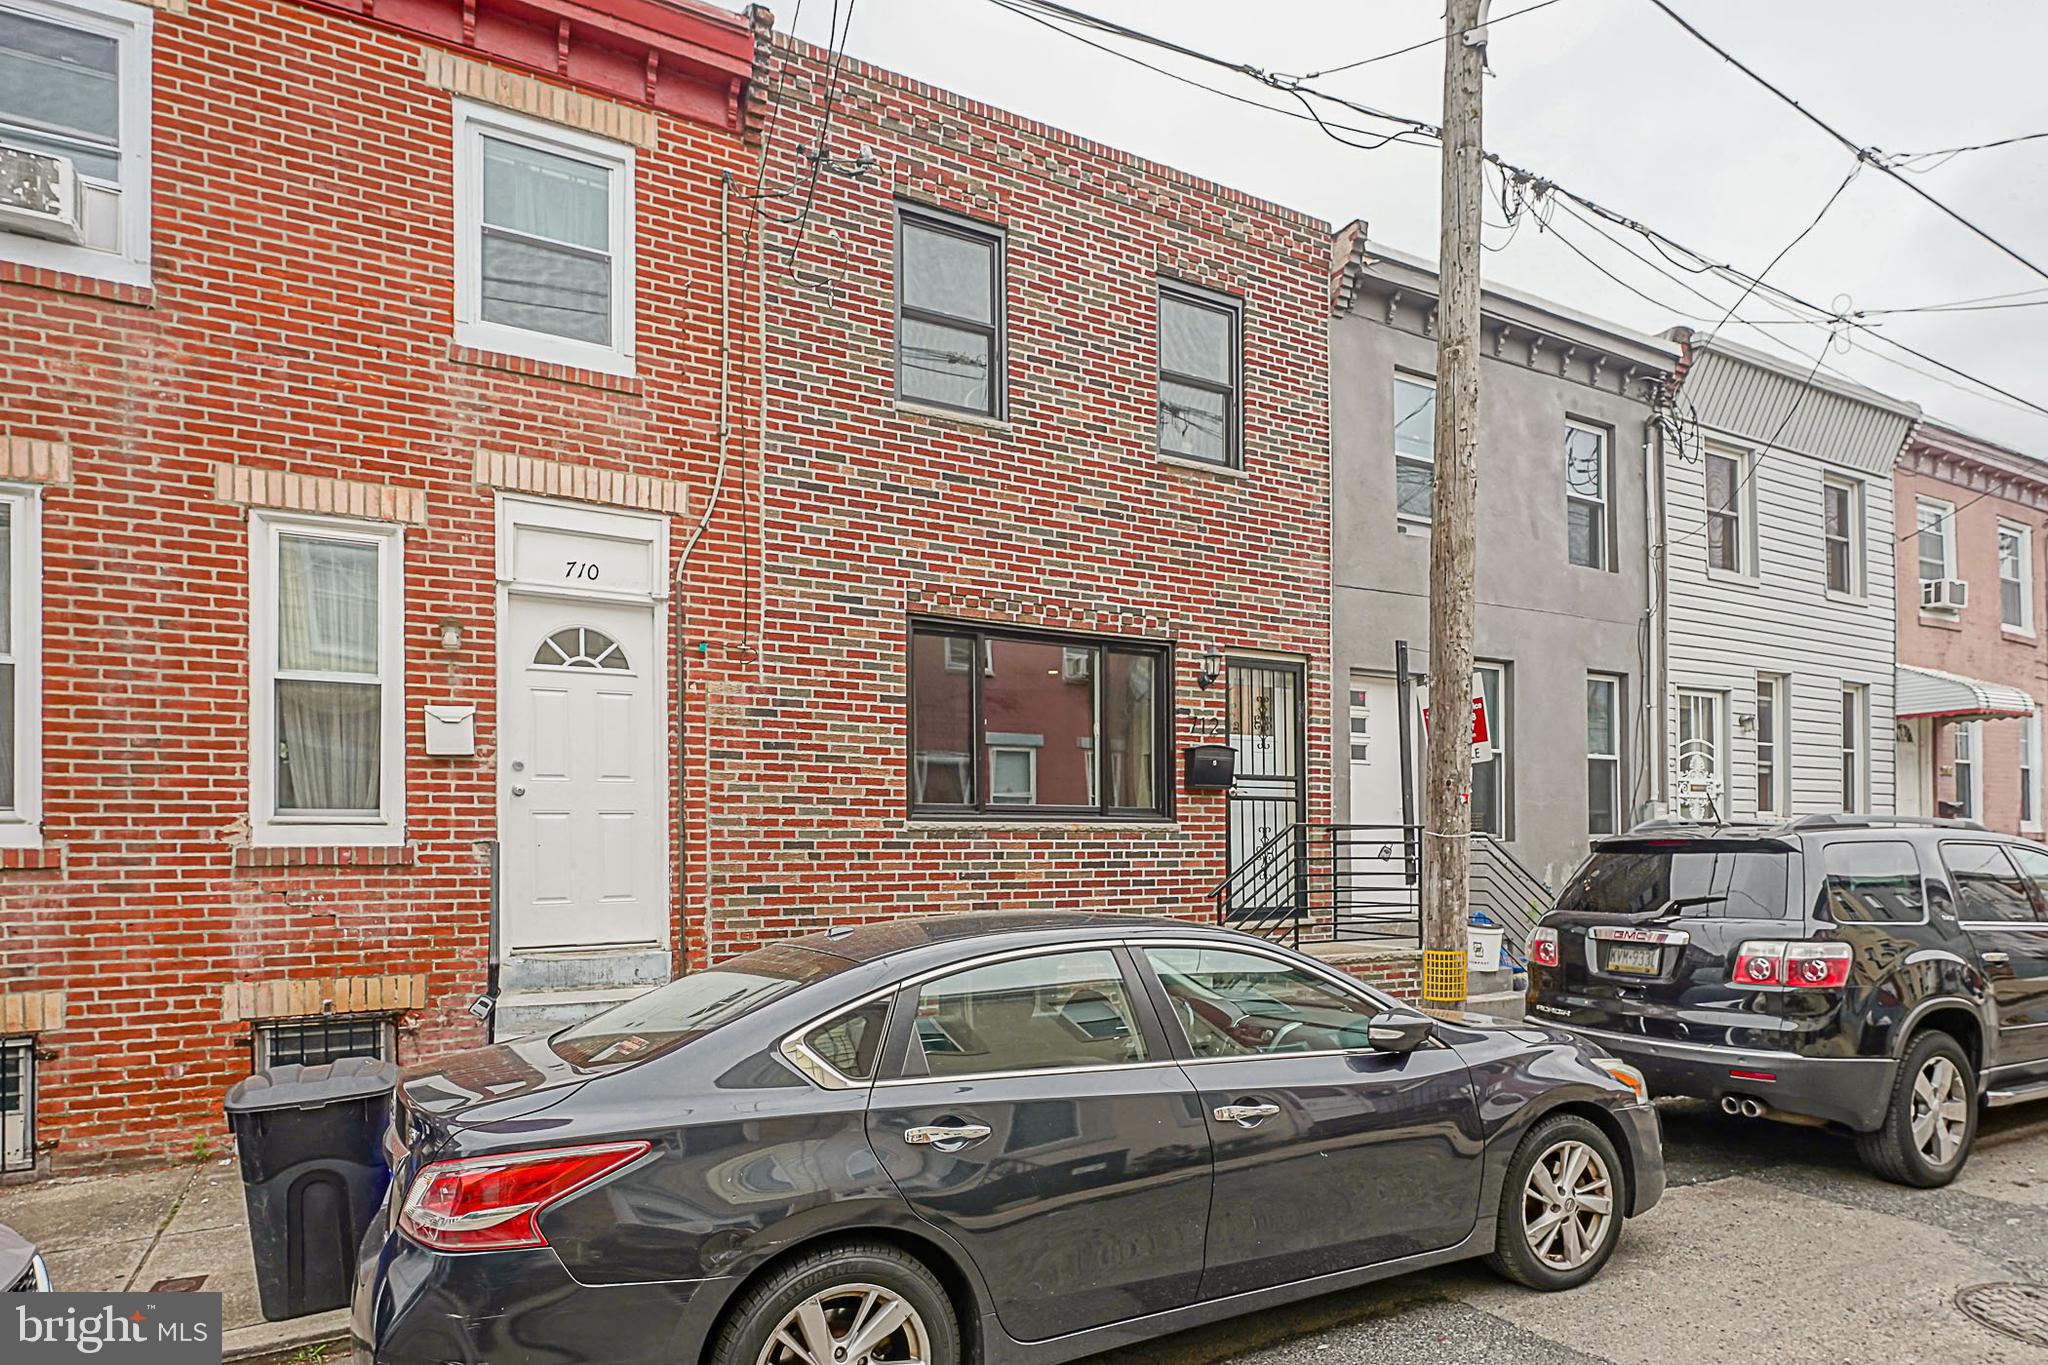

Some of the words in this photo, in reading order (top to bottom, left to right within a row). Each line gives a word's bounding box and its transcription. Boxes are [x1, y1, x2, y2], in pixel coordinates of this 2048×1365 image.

[565, 561, 599, 581] 710
[1189, 716, 1219, 735] 712
[1614, 930, 1647, 940] GMC
